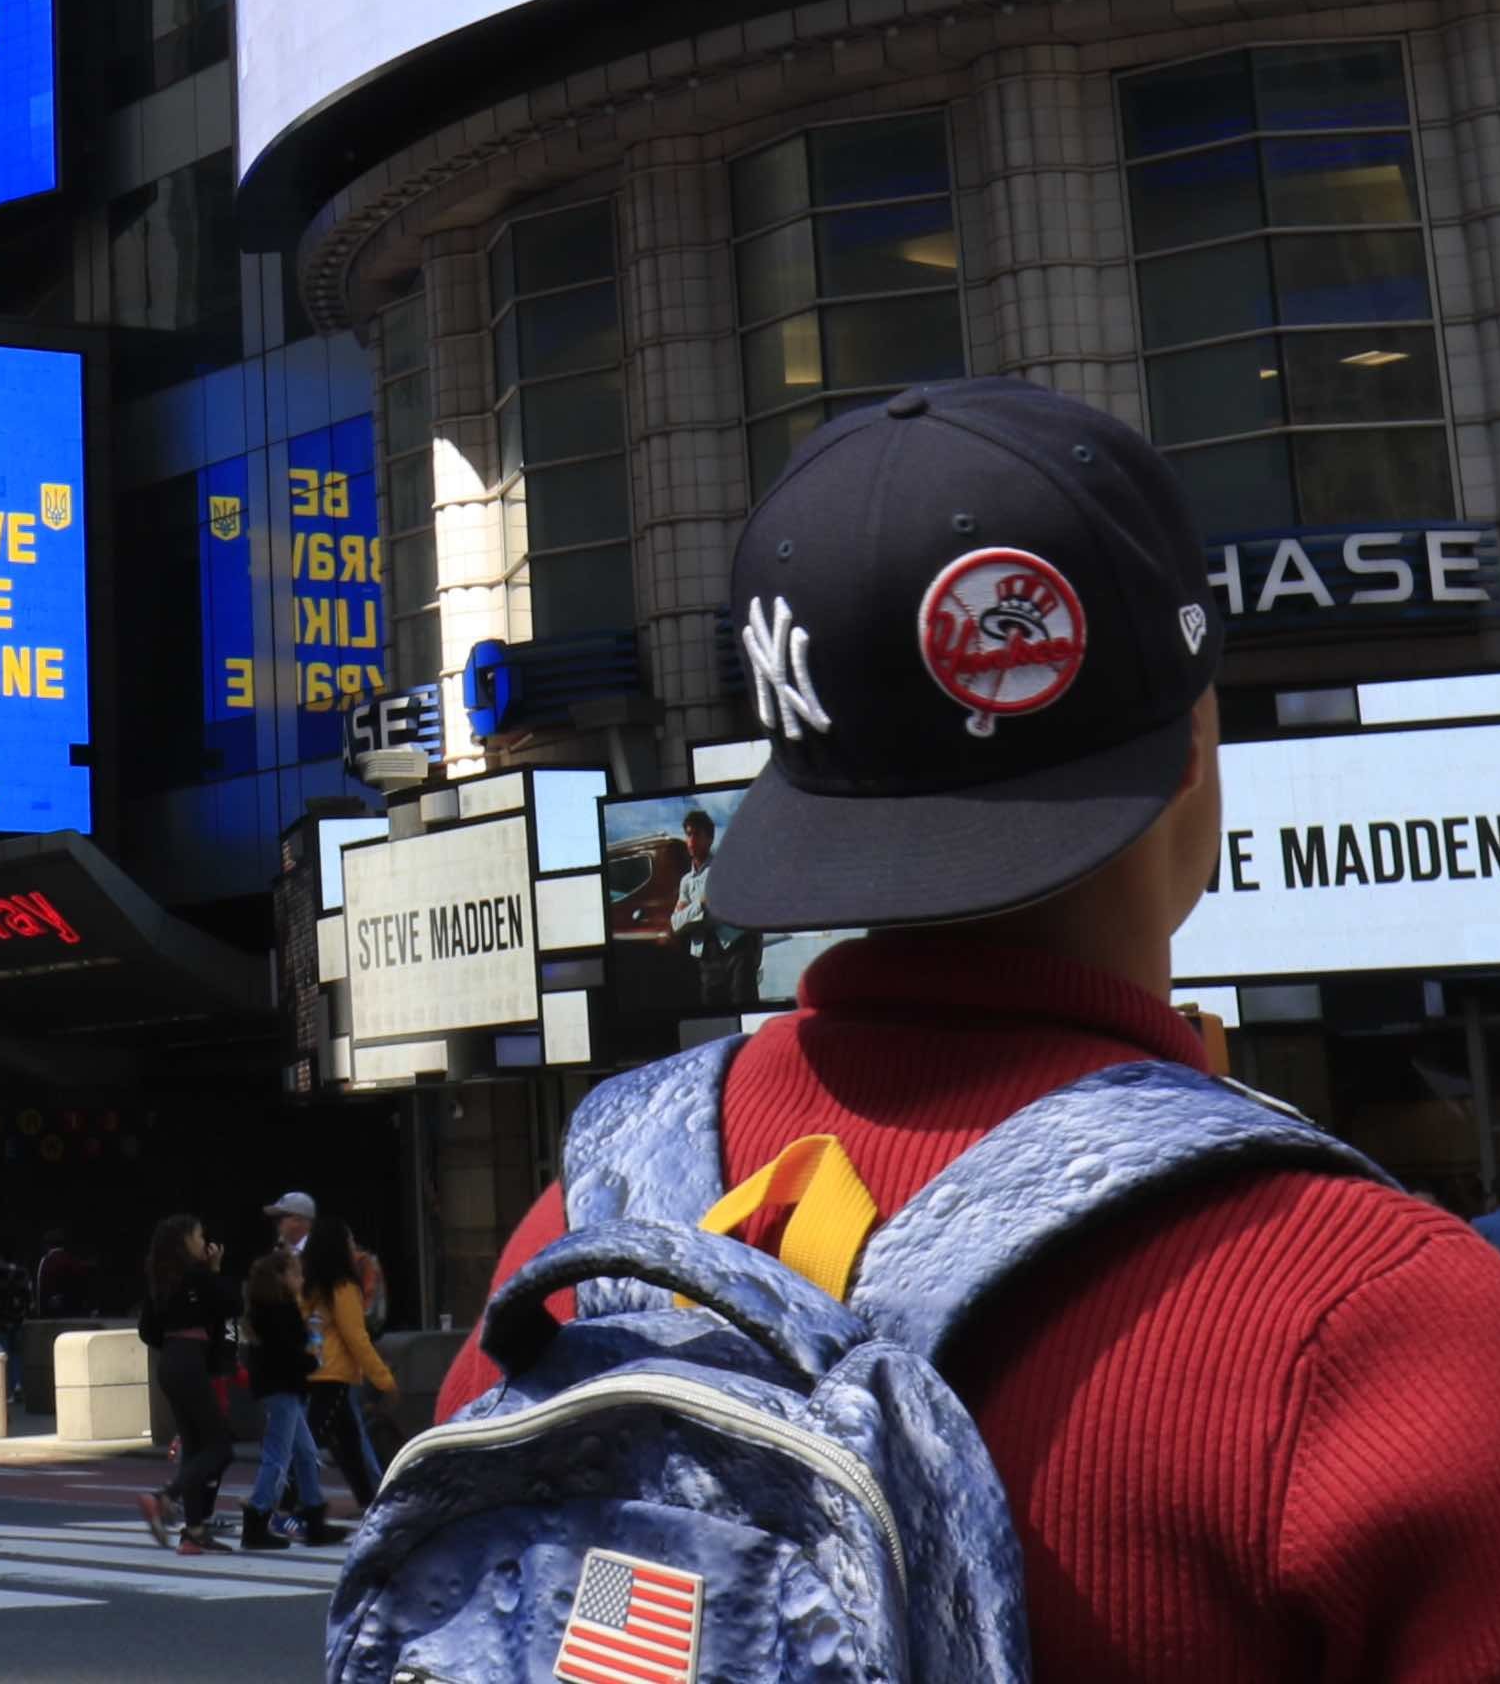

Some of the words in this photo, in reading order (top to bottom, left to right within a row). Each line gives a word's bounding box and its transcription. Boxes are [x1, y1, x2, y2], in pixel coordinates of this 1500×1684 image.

[1207, 530, 1494, 614] HASE
[742, 596, 831, 741] NY
[357, 906, 422, 972] STEVE
[428, 892, 524, 961] MADDEN
